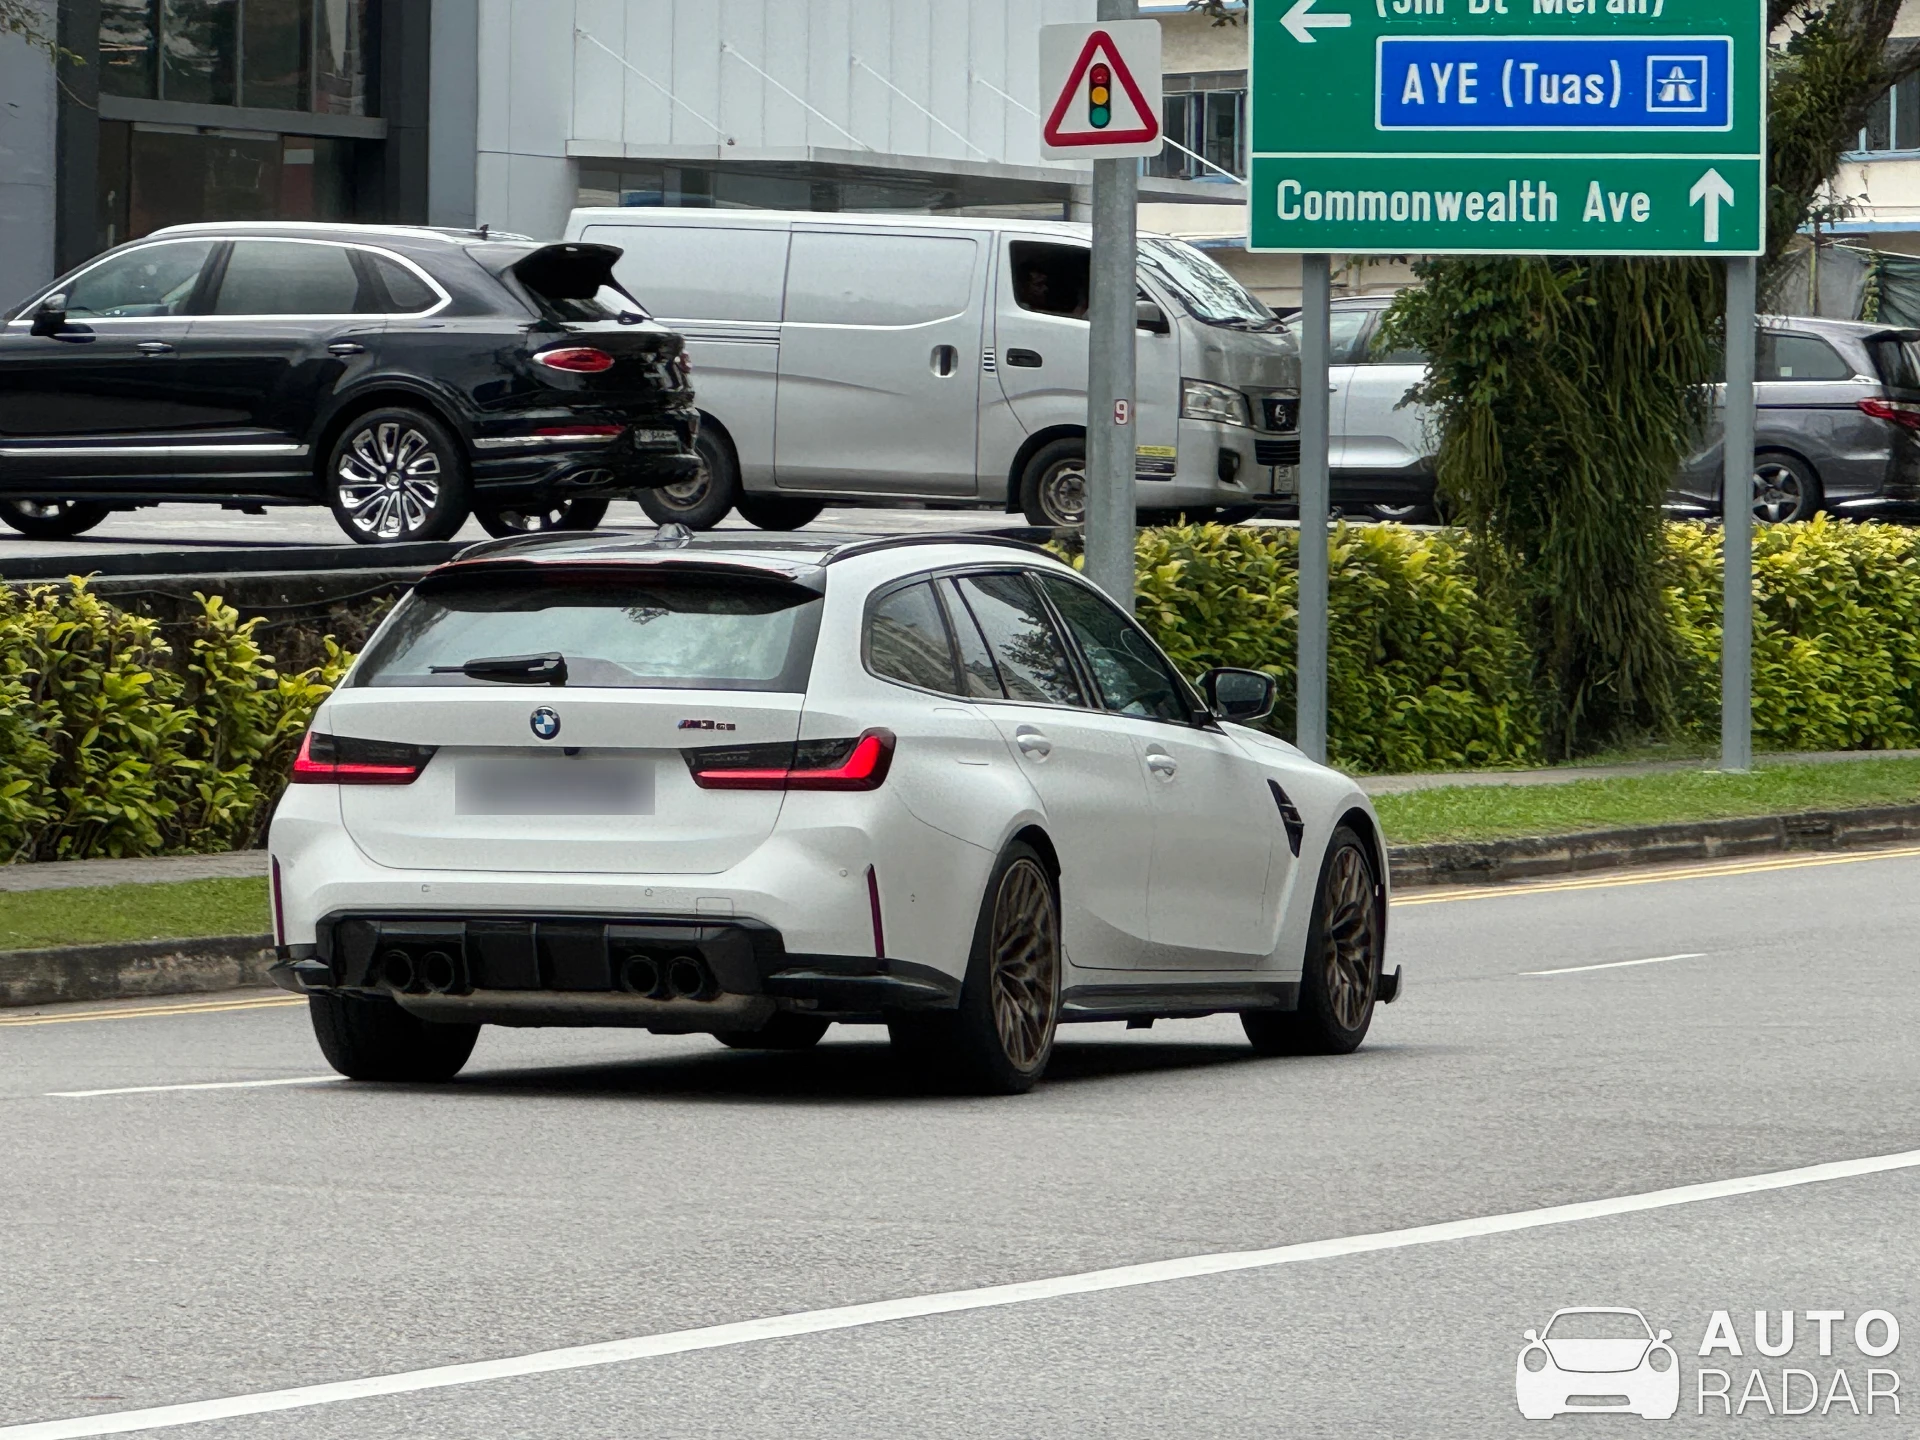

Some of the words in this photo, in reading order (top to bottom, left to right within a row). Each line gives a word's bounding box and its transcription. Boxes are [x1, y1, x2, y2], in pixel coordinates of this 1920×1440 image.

[1401, 62, 1479, 106] AYE
[1501, 58, 1622, 109] (Tuas)
[1276, 179, 1558, 223] Commonwealth
[1582, 180, 1651, 223] Ave
[1114, 399, 1129, 425] 9
